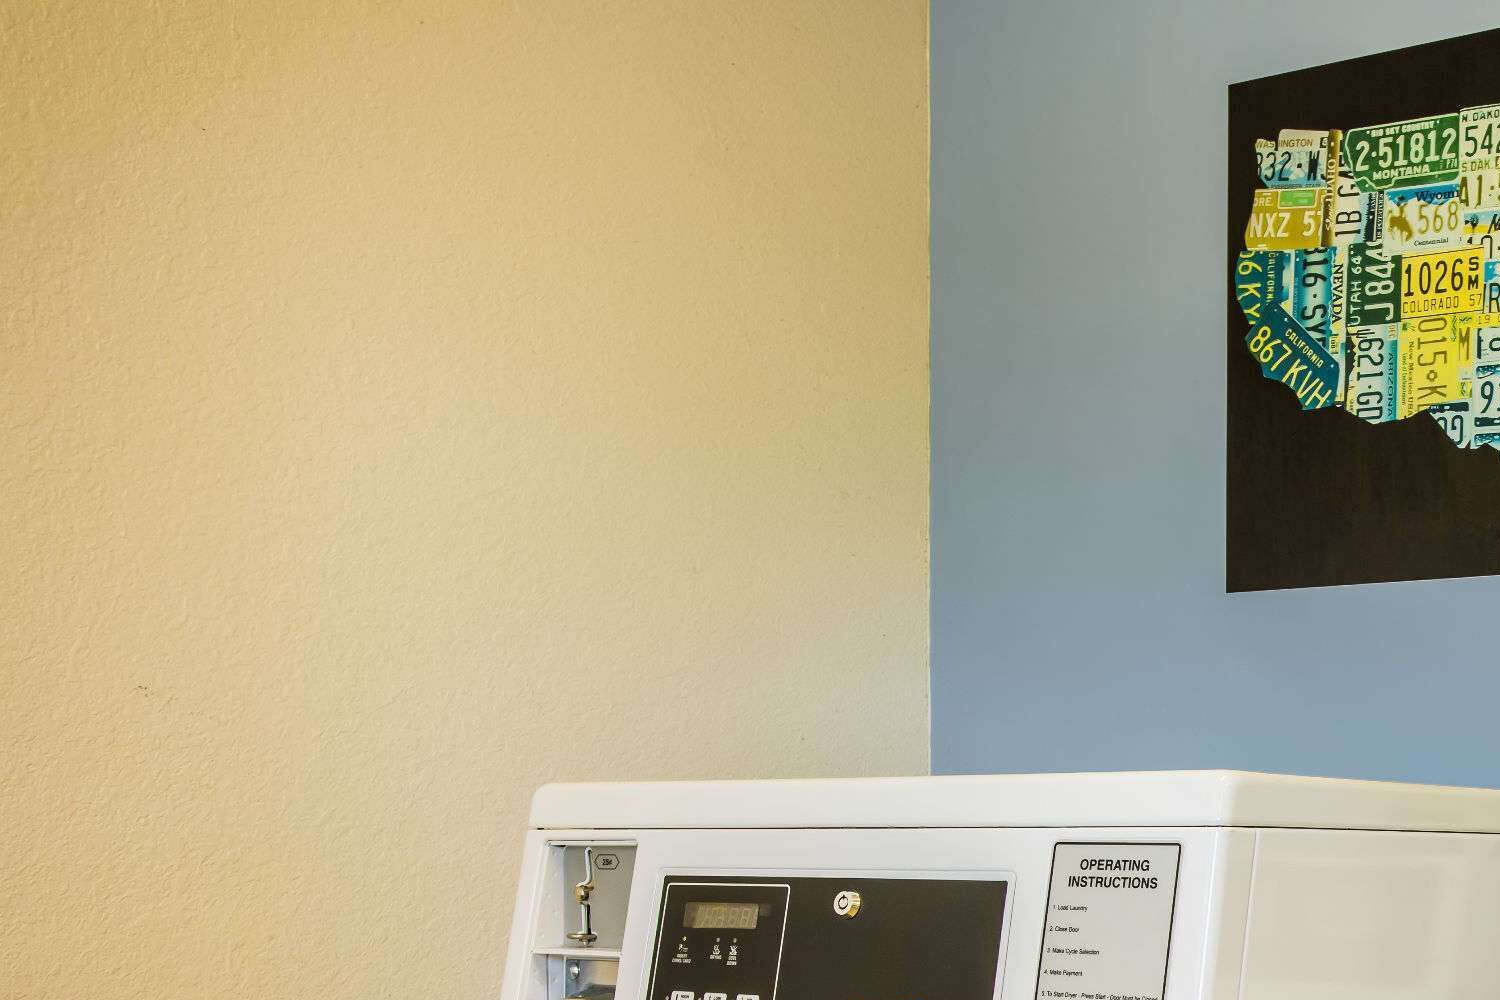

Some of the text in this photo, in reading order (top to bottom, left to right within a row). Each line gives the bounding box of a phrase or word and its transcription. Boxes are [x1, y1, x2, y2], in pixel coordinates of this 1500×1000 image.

[1372, 164, 1430, 180] MONTANA
[1249, 211, 1290, 239] NXZ
[1418, 200, 1459, 235] 568
[1404, 257, 1464, 298] 1026
[1331, 262, 1344, 325] NEVADA
[1349, 281, 1362, 327] UTAH
[1402, 293, 1482, 315] COLORADO 57
[1284, 328, 1325, 369] CALIFORNIA
[1387, 352, 1395, 418] ARIZONA
[1079, 858, 1151, 872] OPERATING
[1067, 875, 1159, 889] INSTRUCTIONS
[1069, 904, 1088, 912] Laundry
[1062, 969, 1083, 977] Payment
